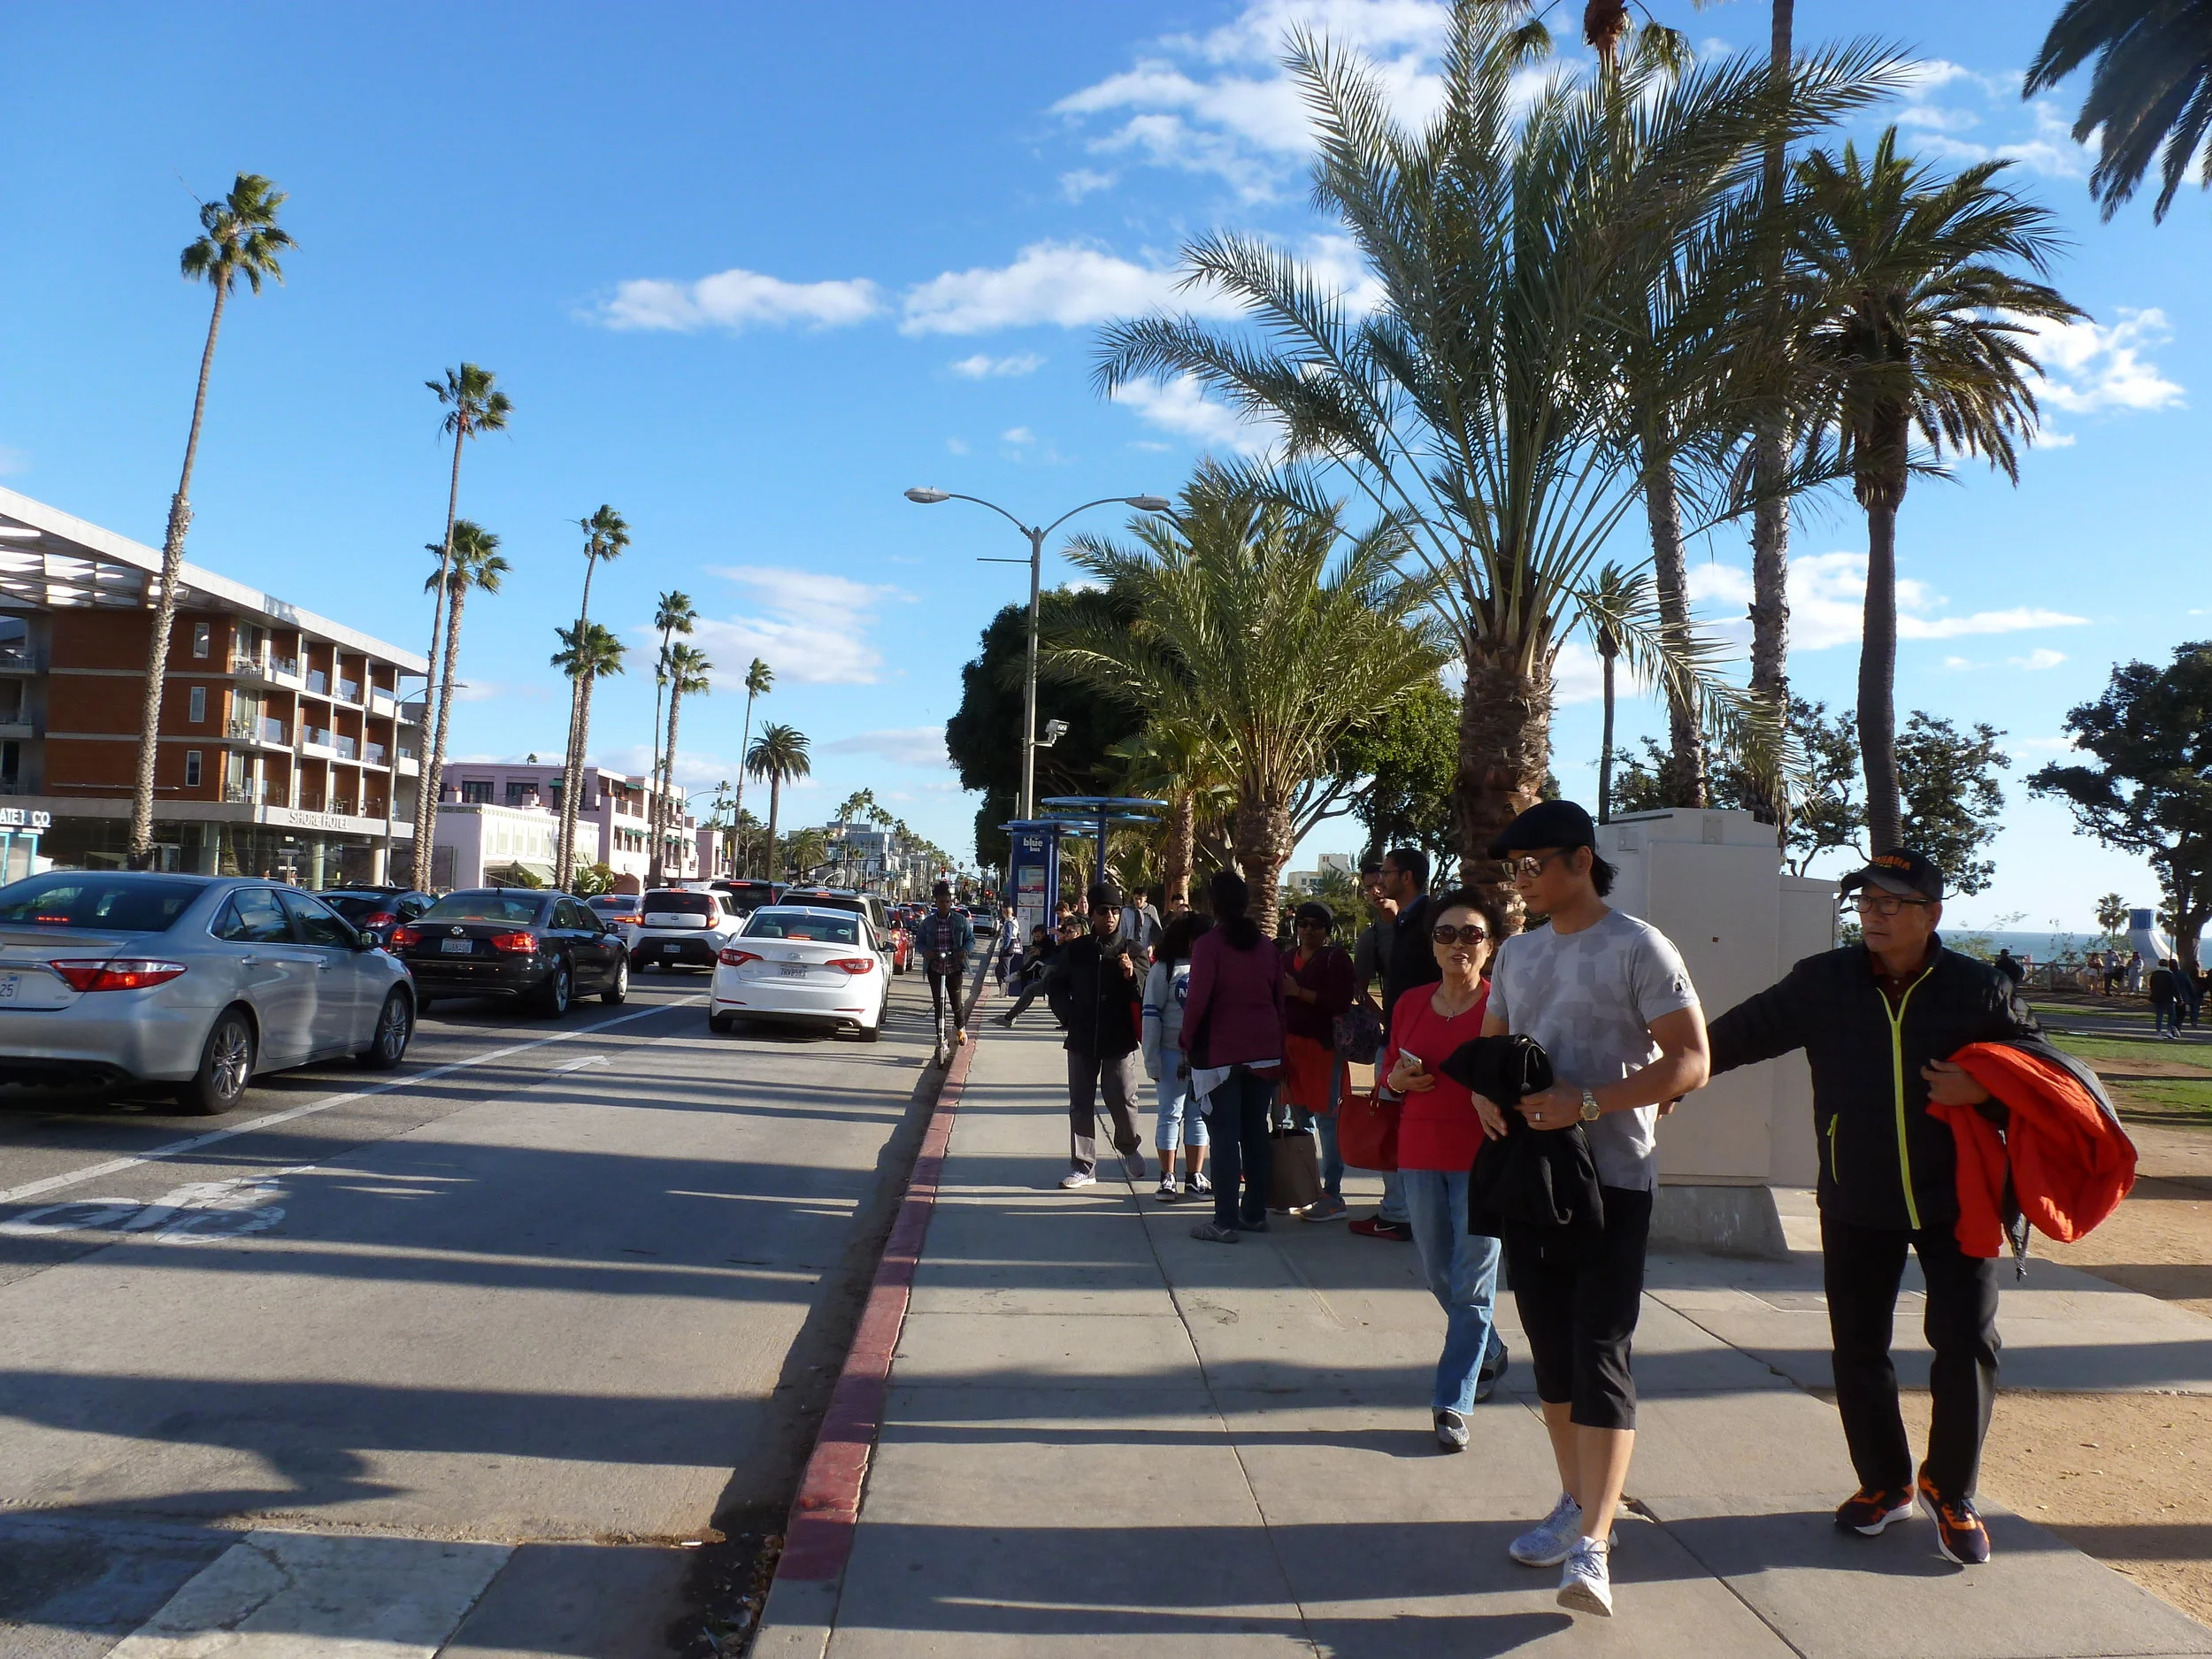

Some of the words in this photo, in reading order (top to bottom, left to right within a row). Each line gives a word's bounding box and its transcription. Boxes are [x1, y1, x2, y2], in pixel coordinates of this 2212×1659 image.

[289, 810, 321, 826] SHORE
[322, 815, 349, 829] HOTEL
[1023, 837, 1043, 847] blue
